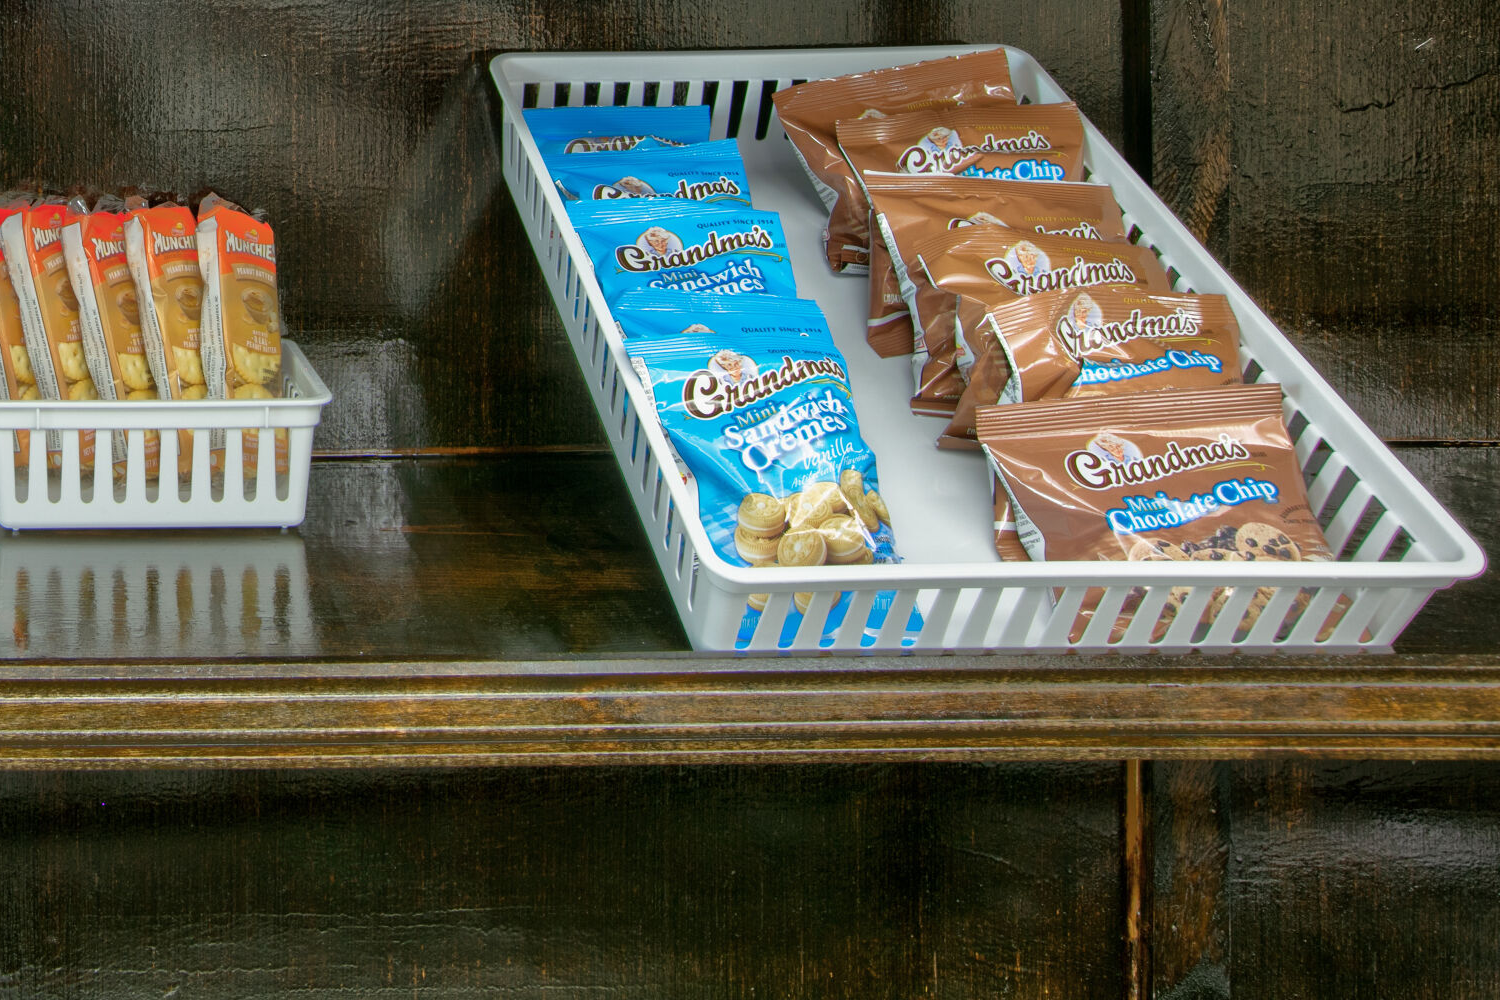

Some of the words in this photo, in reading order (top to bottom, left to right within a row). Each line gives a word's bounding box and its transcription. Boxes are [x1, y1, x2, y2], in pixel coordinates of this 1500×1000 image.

[1014, 160, 1064, 180] Chip
[696, 220, 731, 229] QUALITY
[733, 219, 754, 227] SINCE
[152, 231, 198, 255] MUNCHI
[616, 226, 773, 272] Grandma's
[662, 267, 700, 284] Mini
[741, 326, 777, 334] QUALITY
[1078, 357, 1172, 385] hocolate
[1166, 348, 1222, 374] Chip
[682, 357, 845, 420] Grandma's
[724, 388, 849, 449] Sandwich
[736, 402, 780, 429] Mini
[740, 413, 848, 471] Cremes
[803, 436, 863, 470] Vanilla
[1064, 433, 1248, 490] Grandma's
[1108, 493, 1217, 534] Chocolate
[1216, 478, 1278, 504] Chip
[1128, 491, 1168, 512] Mini
